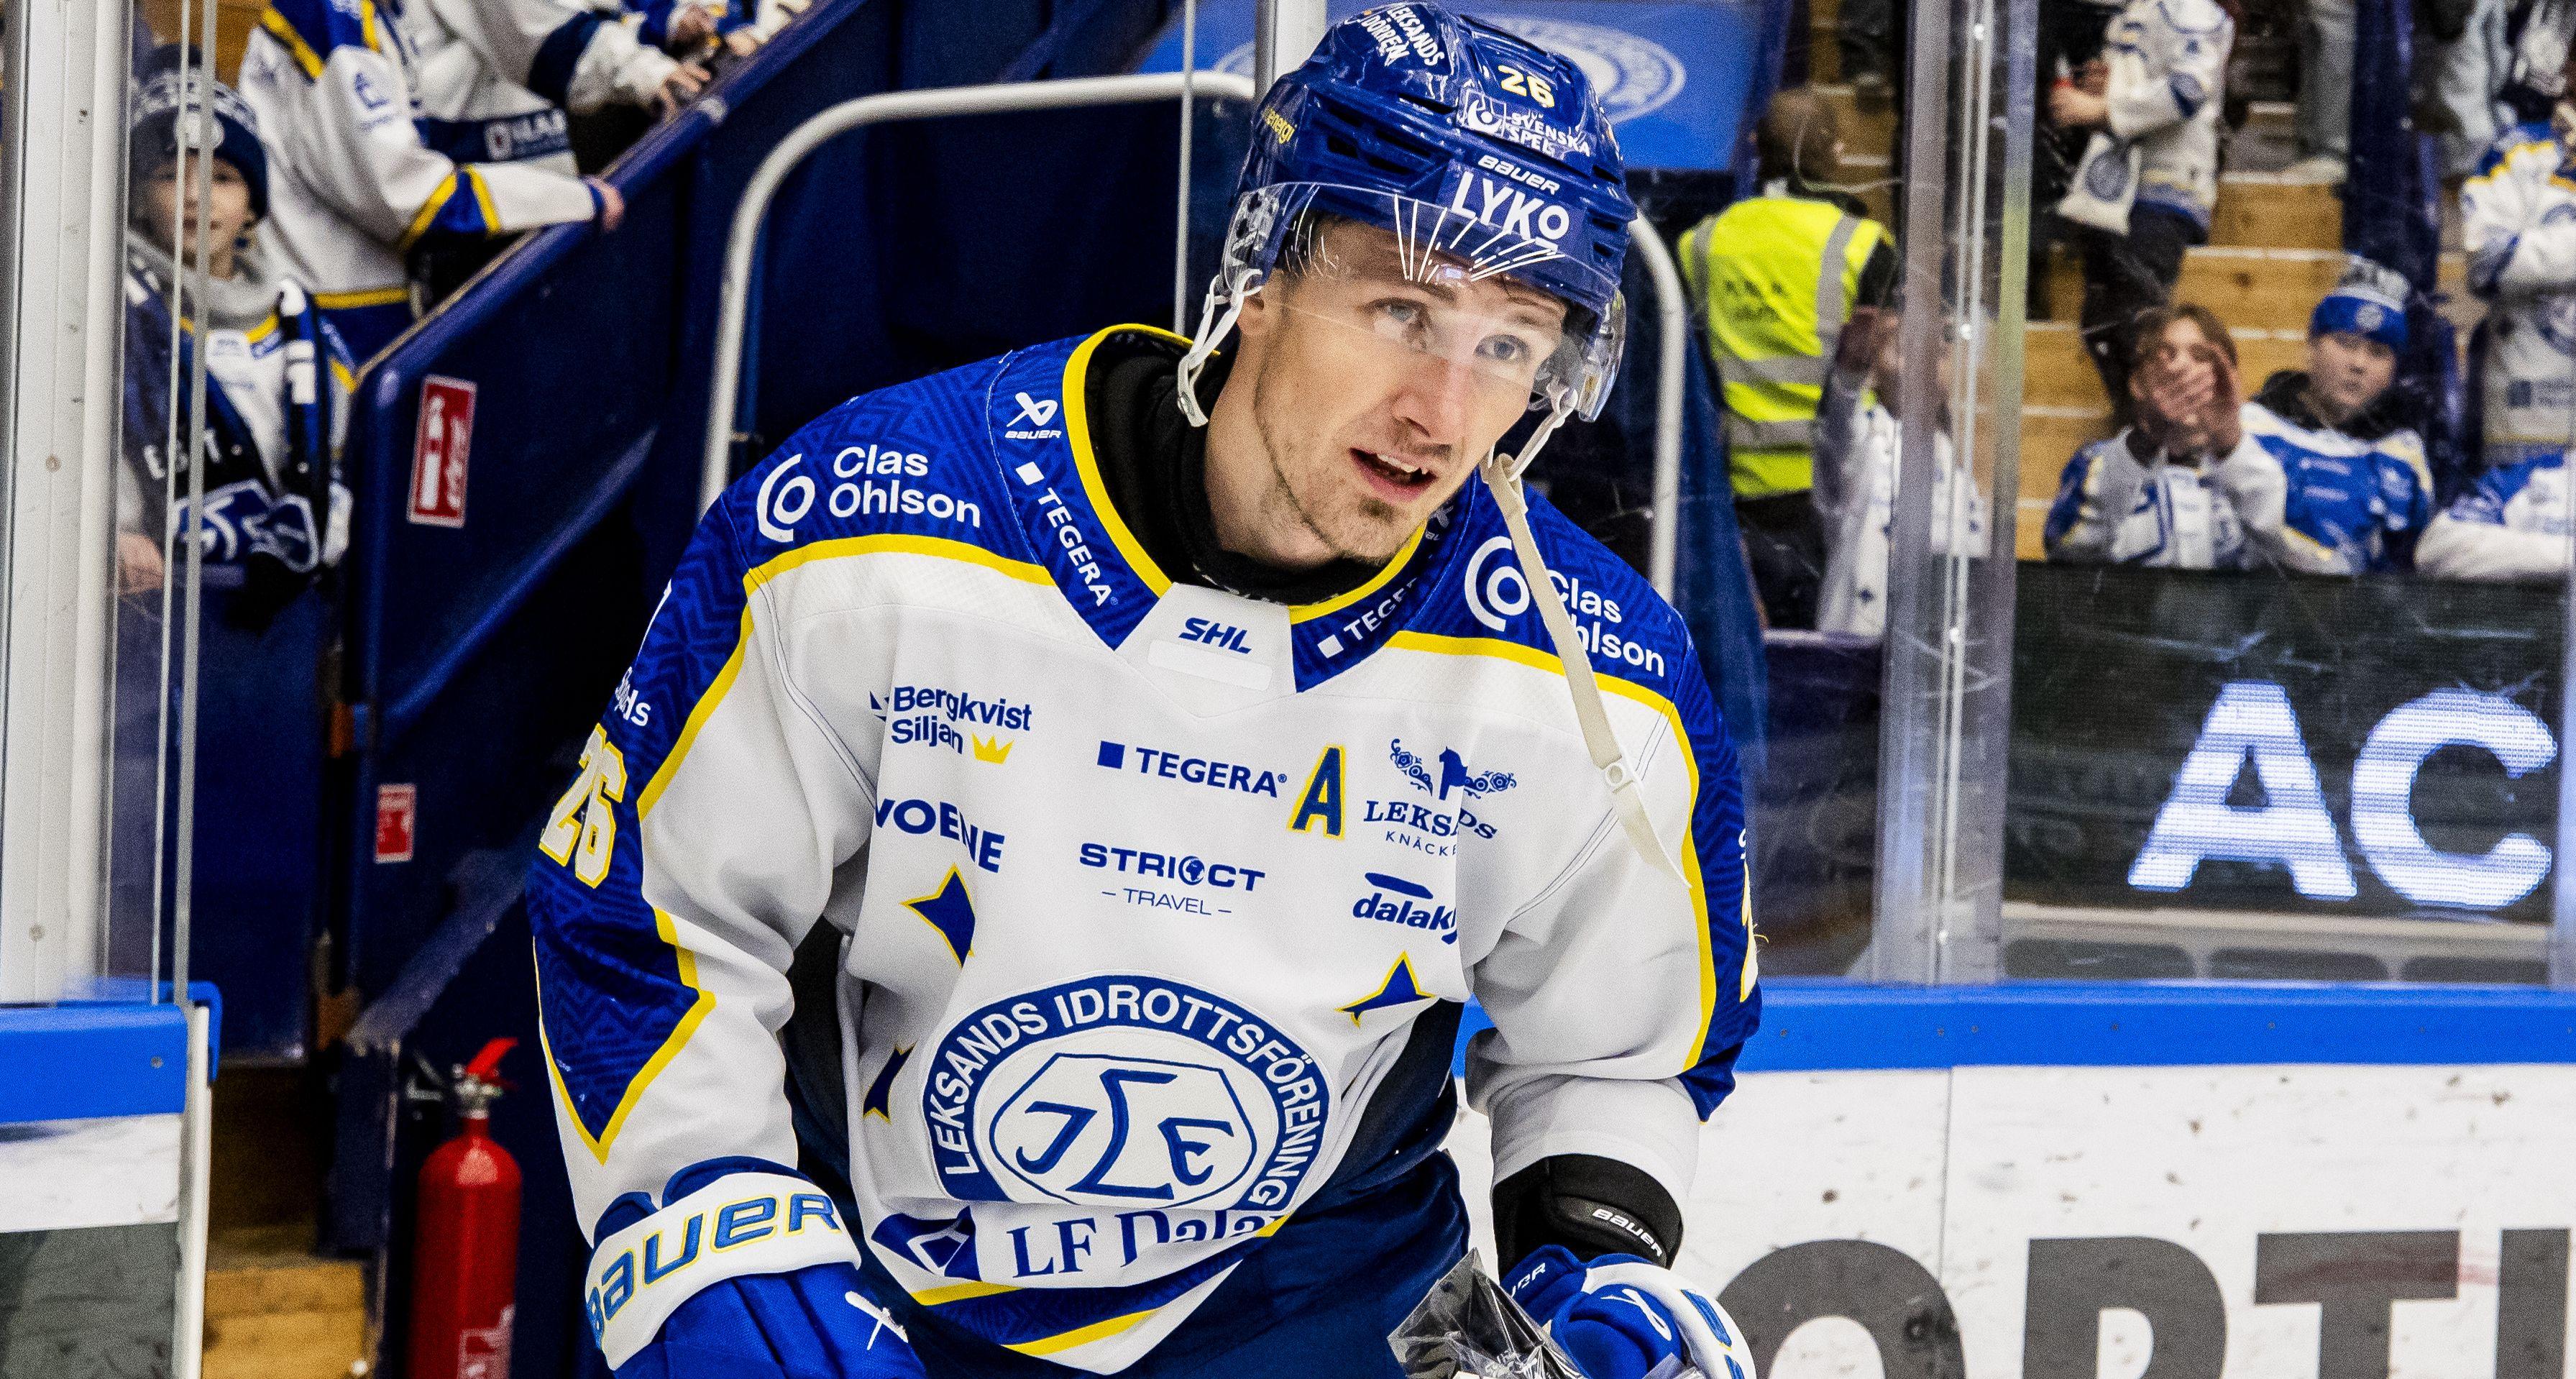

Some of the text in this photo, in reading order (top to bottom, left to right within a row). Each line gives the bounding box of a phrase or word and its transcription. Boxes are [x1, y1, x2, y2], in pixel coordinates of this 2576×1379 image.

[1498, 65, 1555, 108] 26
[1511, 112, 1590, 157] SVENSKA
[1477, 155, 1560, 195] BAUER
[1451, 171, 1569, 251] LYKO
[1004, 430, 1062, 439] BAUER
[833, 444, 928, 478] Clas
[828, 480, 981, 528] Ohlson
[1546, 569, 1622, 623] Clas
[1178, 617, 1252, 654] SHL
[1570, 613, 1664, 677] hlson
[893, 685, 1032, 731] Bergkvist
[891, 715, 963, 755] Siljan
[538, 722, 628, 889] 26
[1286, 743, 1347, 840] A
[2127, 679, 2558, 912] AC
[1122, 887, 1212, 916] TRAVEL
[926, 984, 1325, 1208] LEKSANDS IDROTTSFÖRENING
[1007, 1217, 1097, 1279] LF
[1592, 1208, 1664, 1257] BAUER
